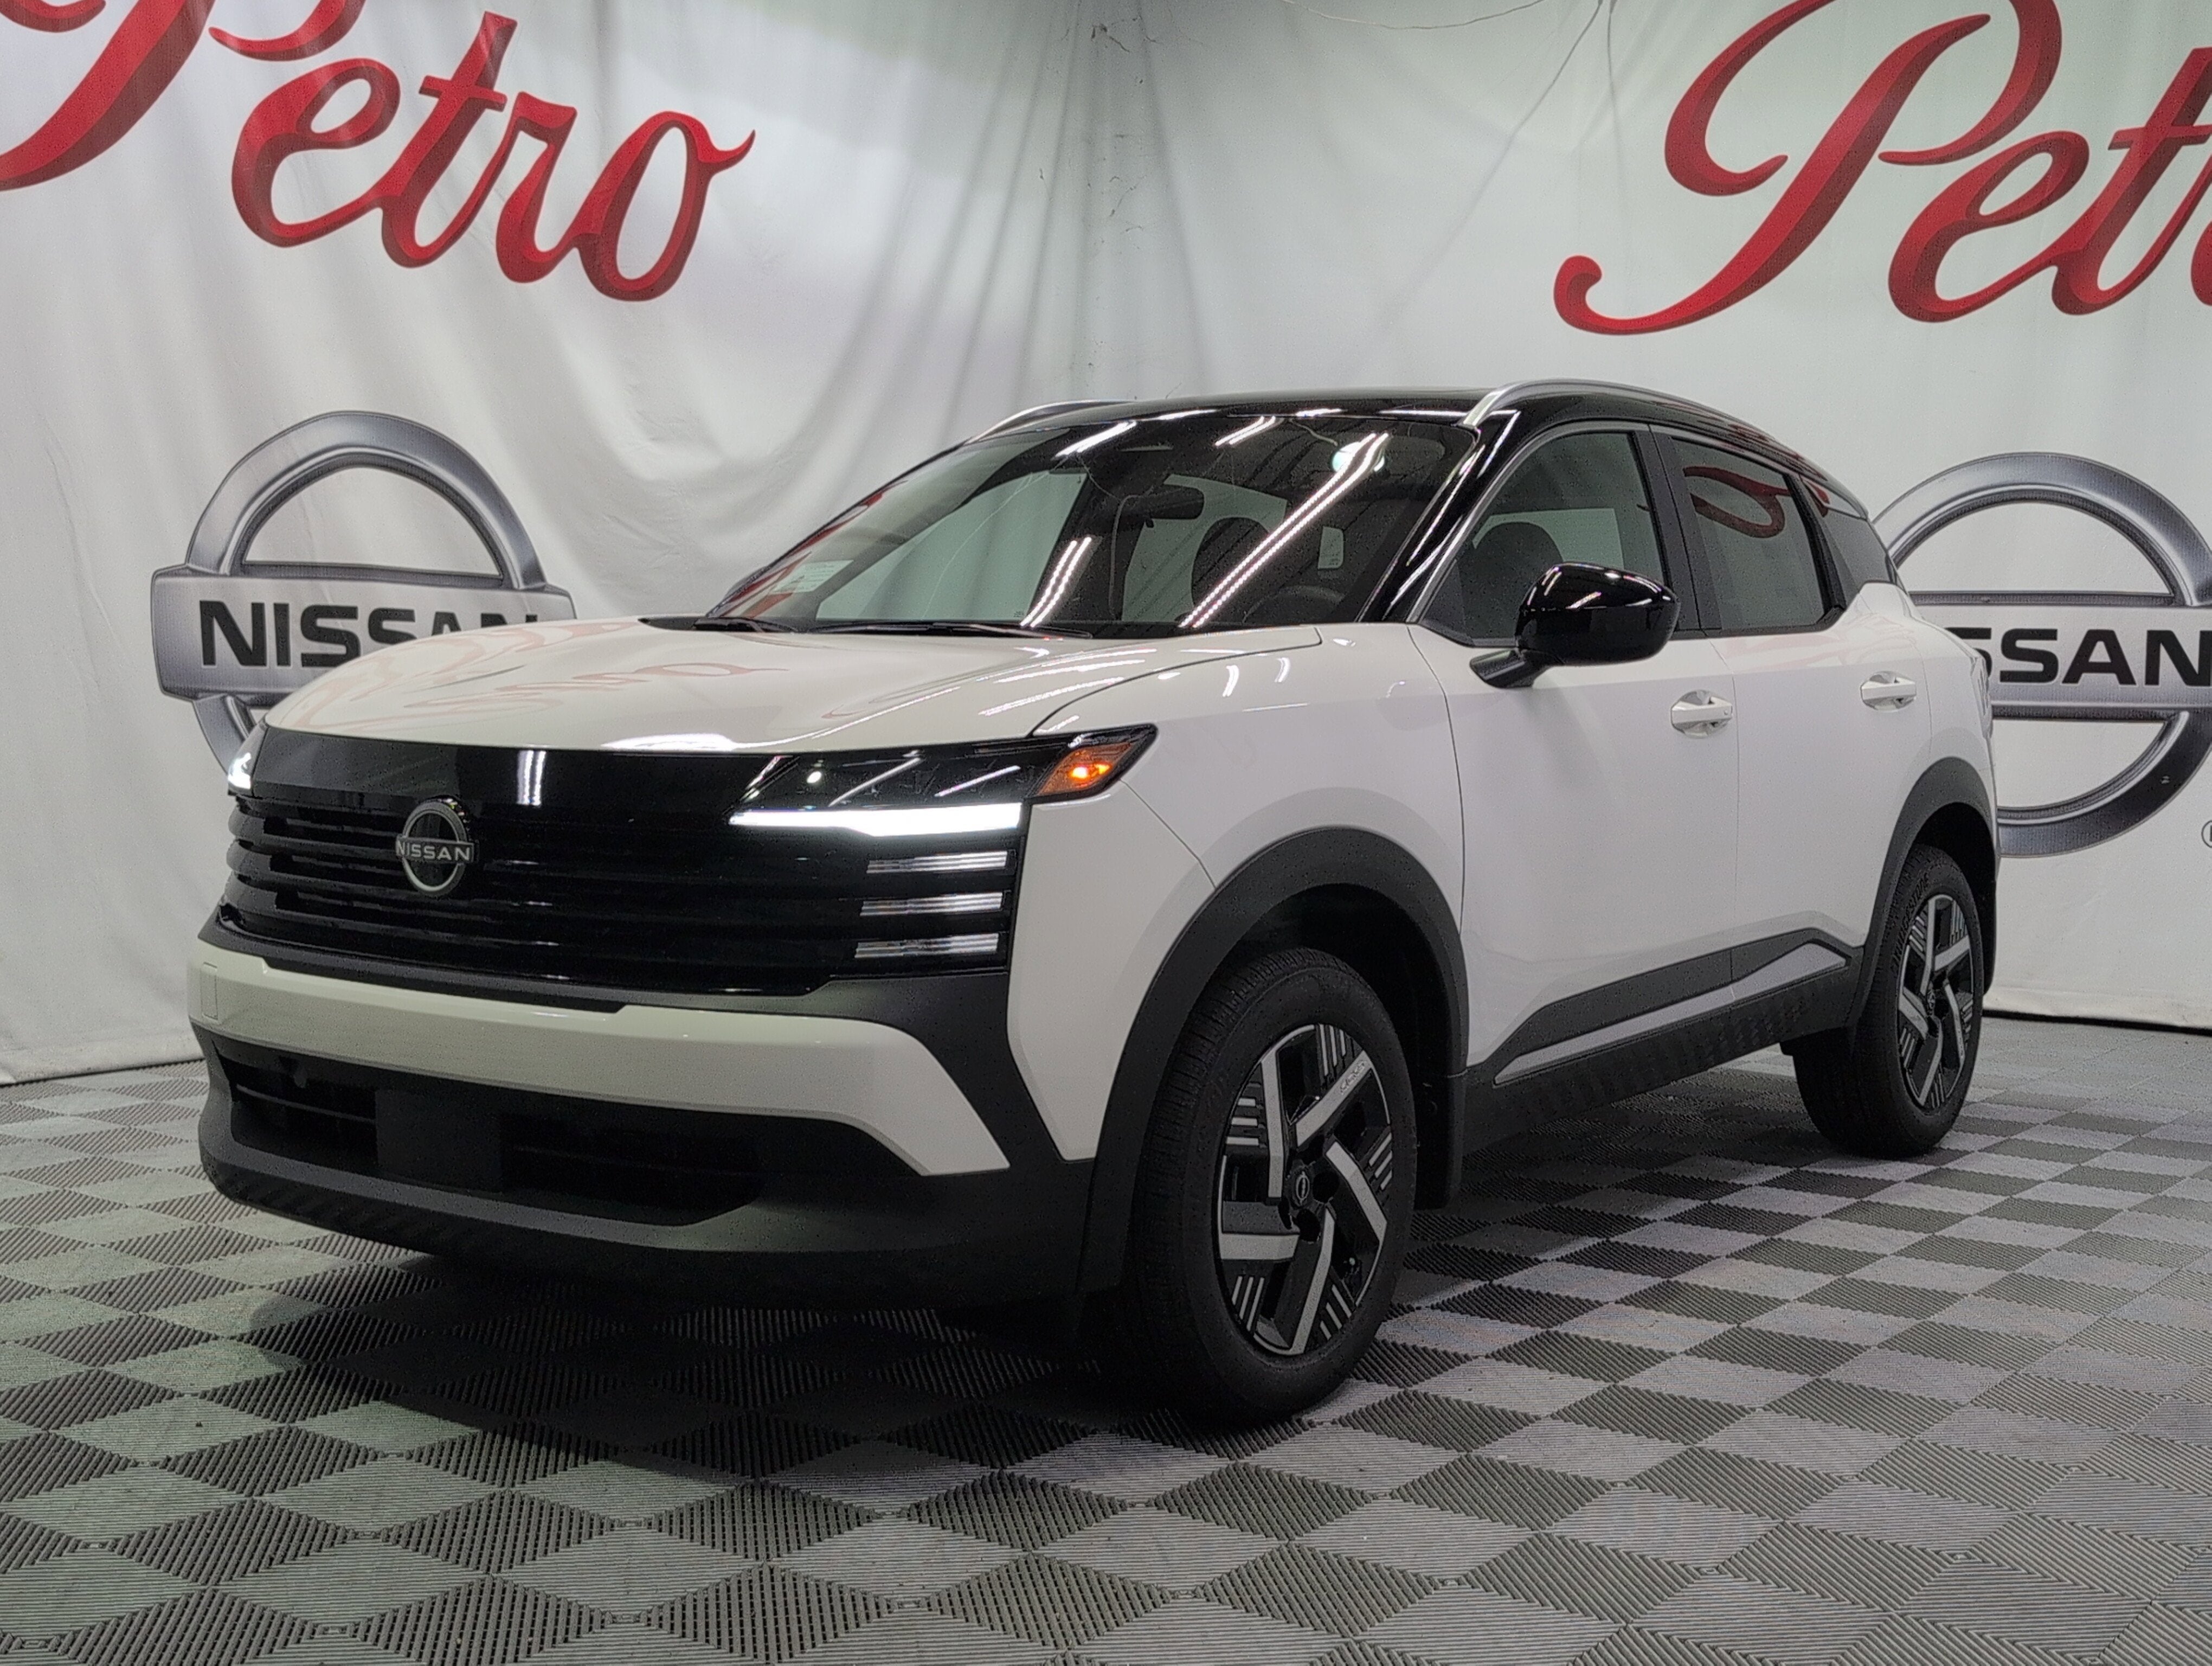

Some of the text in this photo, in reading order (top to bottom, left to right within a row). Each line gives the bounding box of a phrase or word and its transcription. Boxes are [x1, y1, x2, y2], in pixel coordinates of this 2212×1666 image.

[1553, 0, 2212, 335] Pet
[200, 600, 538, 668] NISS
[396, 841, 471, 861] NISSAN
